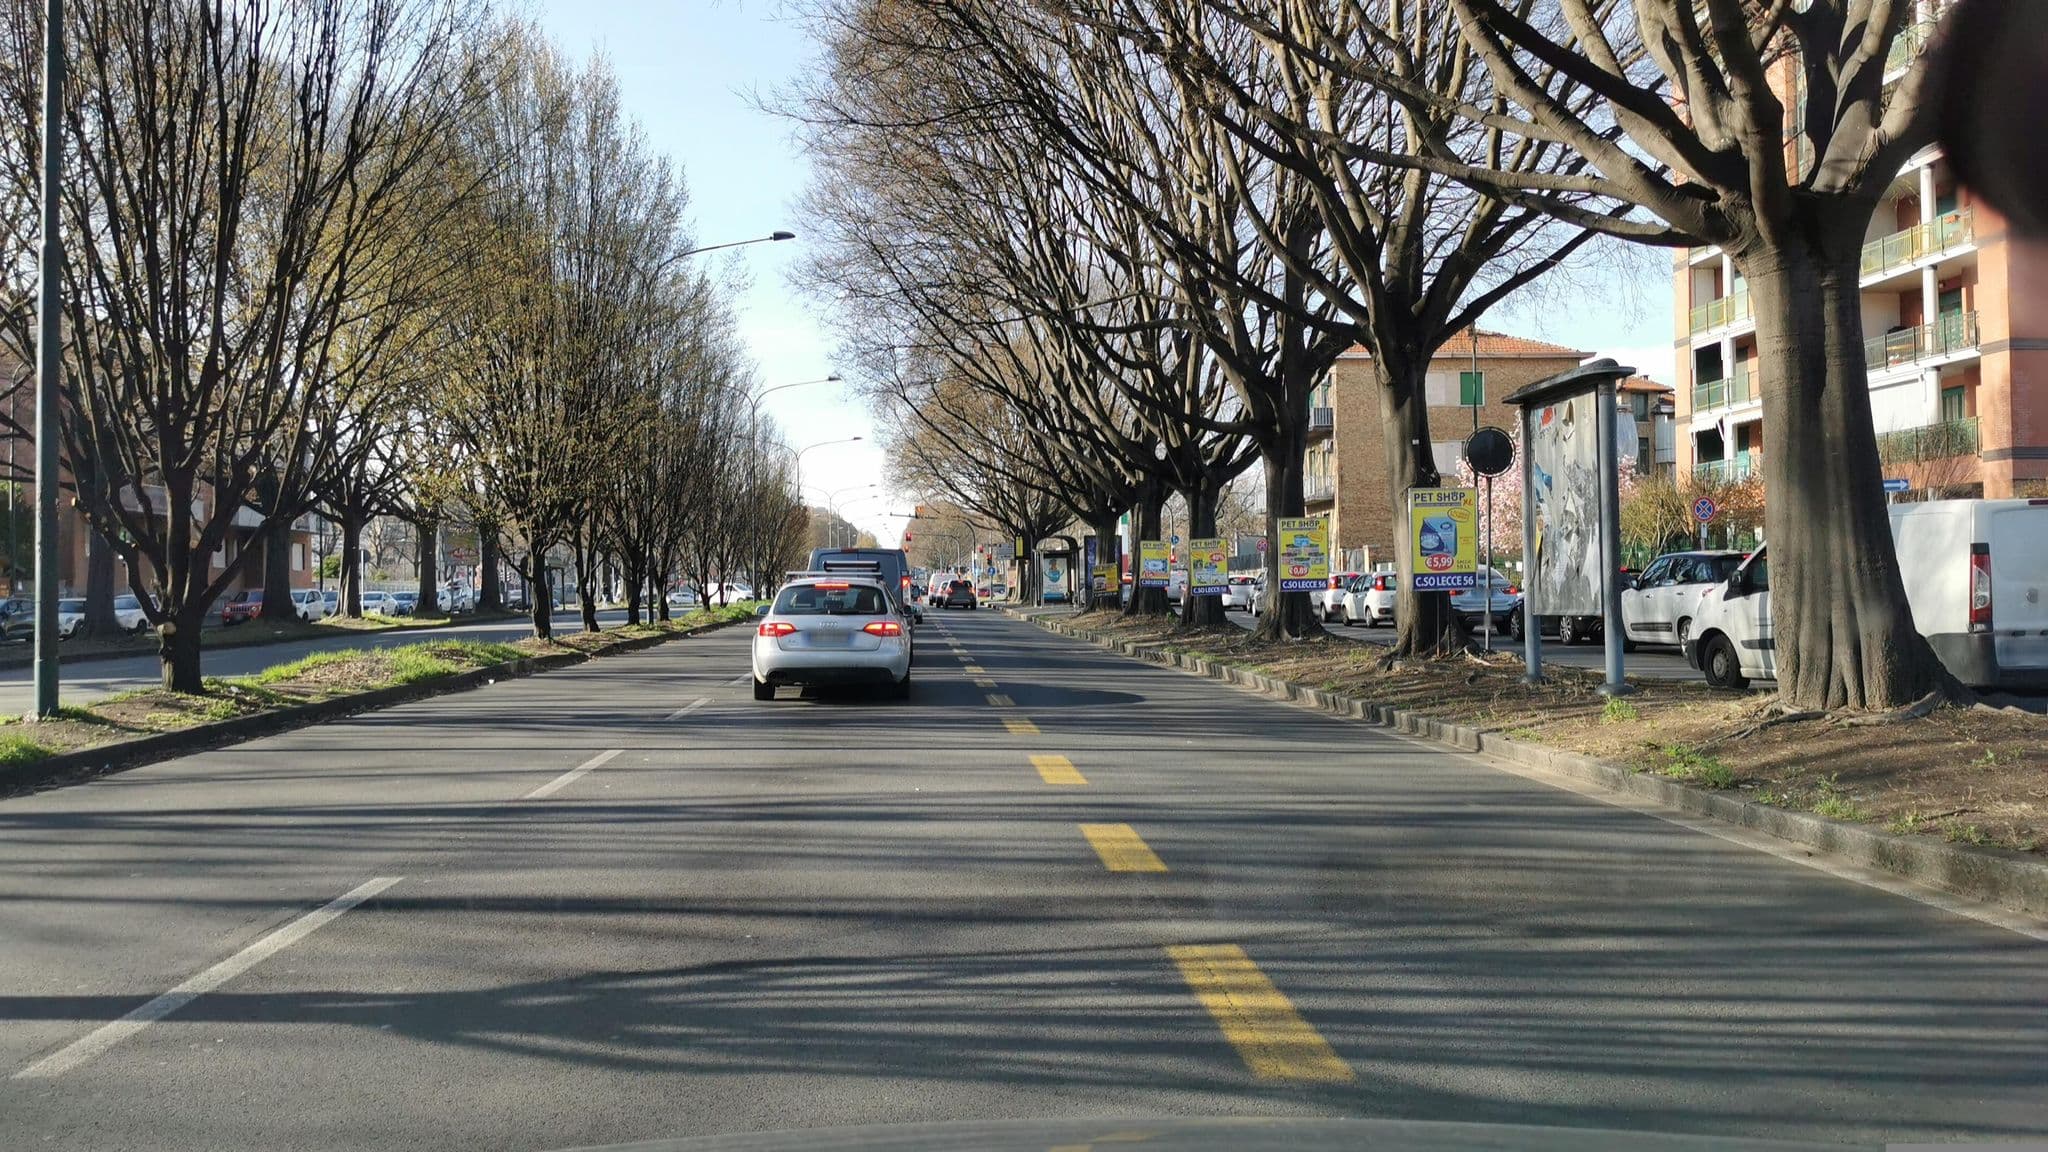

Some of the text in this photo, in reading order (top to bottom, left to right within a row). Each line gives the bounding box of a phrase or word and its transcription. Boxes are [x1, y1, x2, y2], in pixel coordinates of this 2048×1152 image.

[1414, 491, 1466, 502] PET SHOP
[1298, 520, 1320, 528] SHOP
[1282, 581, 1298, 589] C.SO
[1298, 581, 1318, 589] LECCE
[1415, 575, 1474, 587] C.SO LECCE 56
